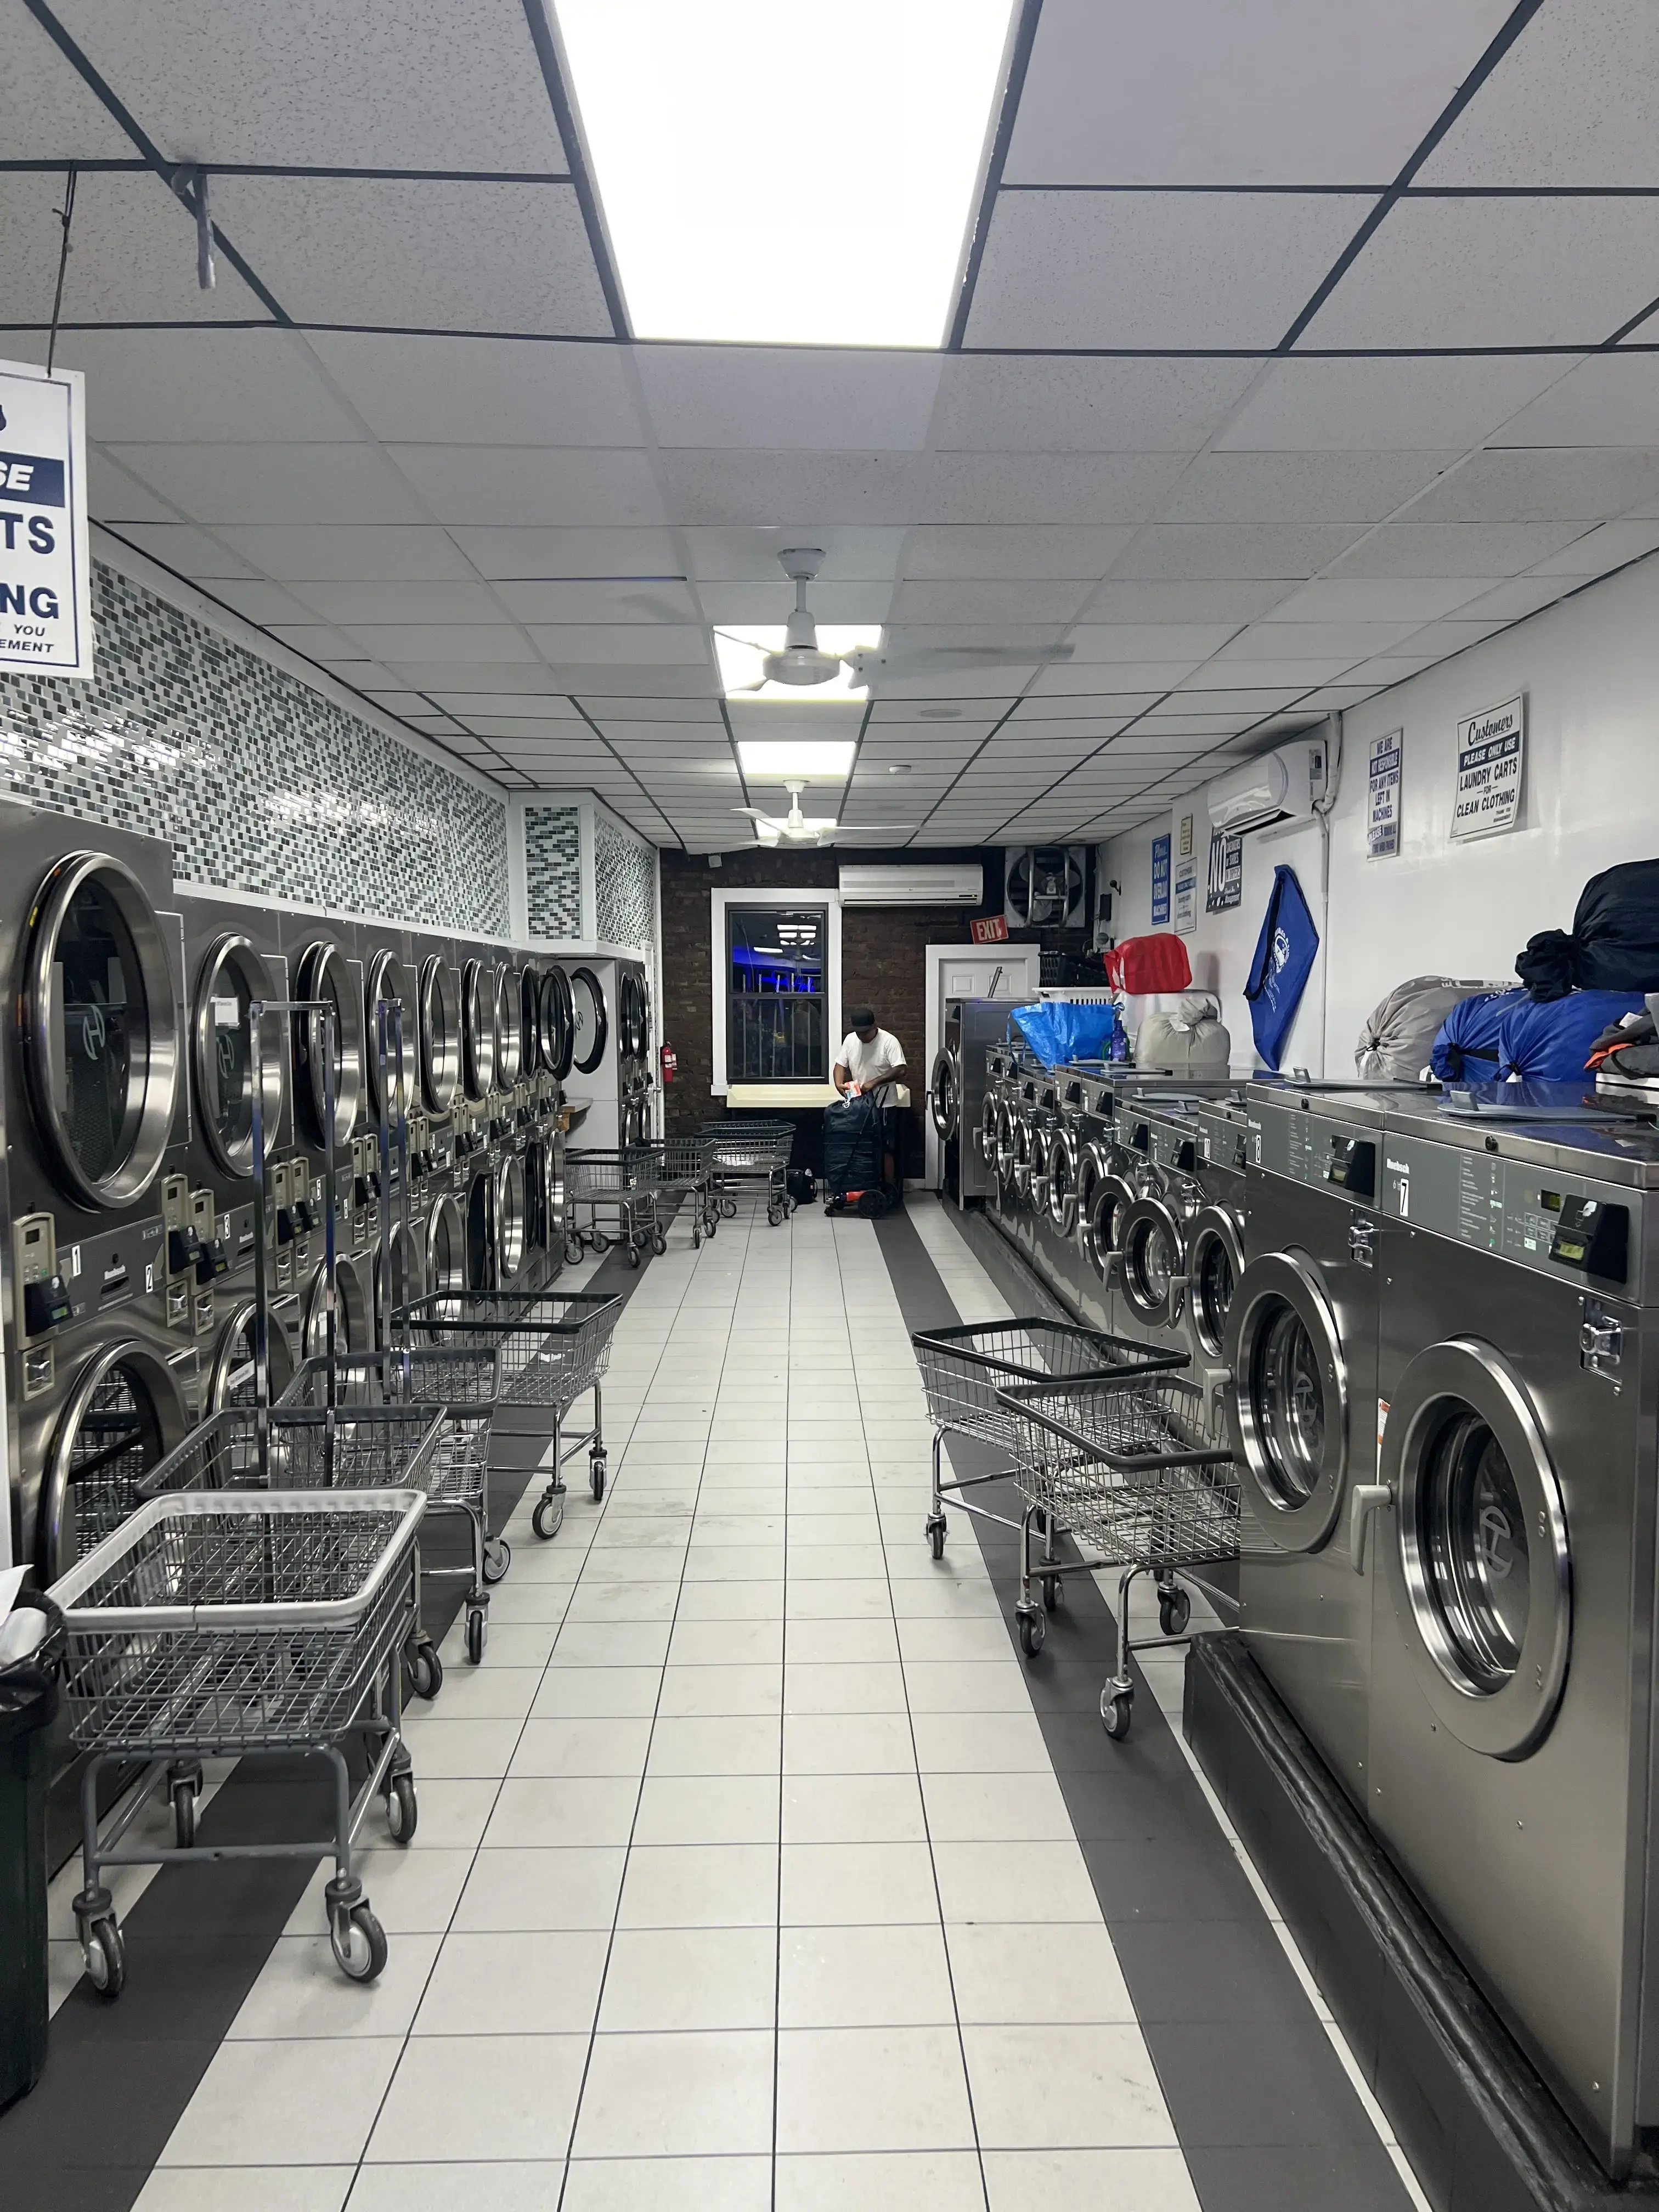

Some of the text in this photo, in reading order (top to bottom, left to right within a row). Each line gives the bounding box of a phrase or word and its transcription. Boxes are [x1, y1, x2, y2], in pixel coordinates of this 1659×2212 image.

[0, 509, 55, 554] TS
[0, 583, 59, 619] NG
[14, 624, 45, 636] YOU
[1468, 714, 1513, 746] Customers
[1464, 737, 1516, 766] PLEASE ONLY USE
[1460, 757, 1517, 791] LAUNDRY CARTS
[1457, 799, 1479, 817] CLEAN
[1482, 788, 1515, 811] CLOTHING
[1210, 837, 1226, 893] NO
[976, 918, 1002, 941] EXIT
[1402, 1182, 1407, 1212] 7
[74, 1248, 79, 1273] 1
[146, 1267, 152, 1290] 2
